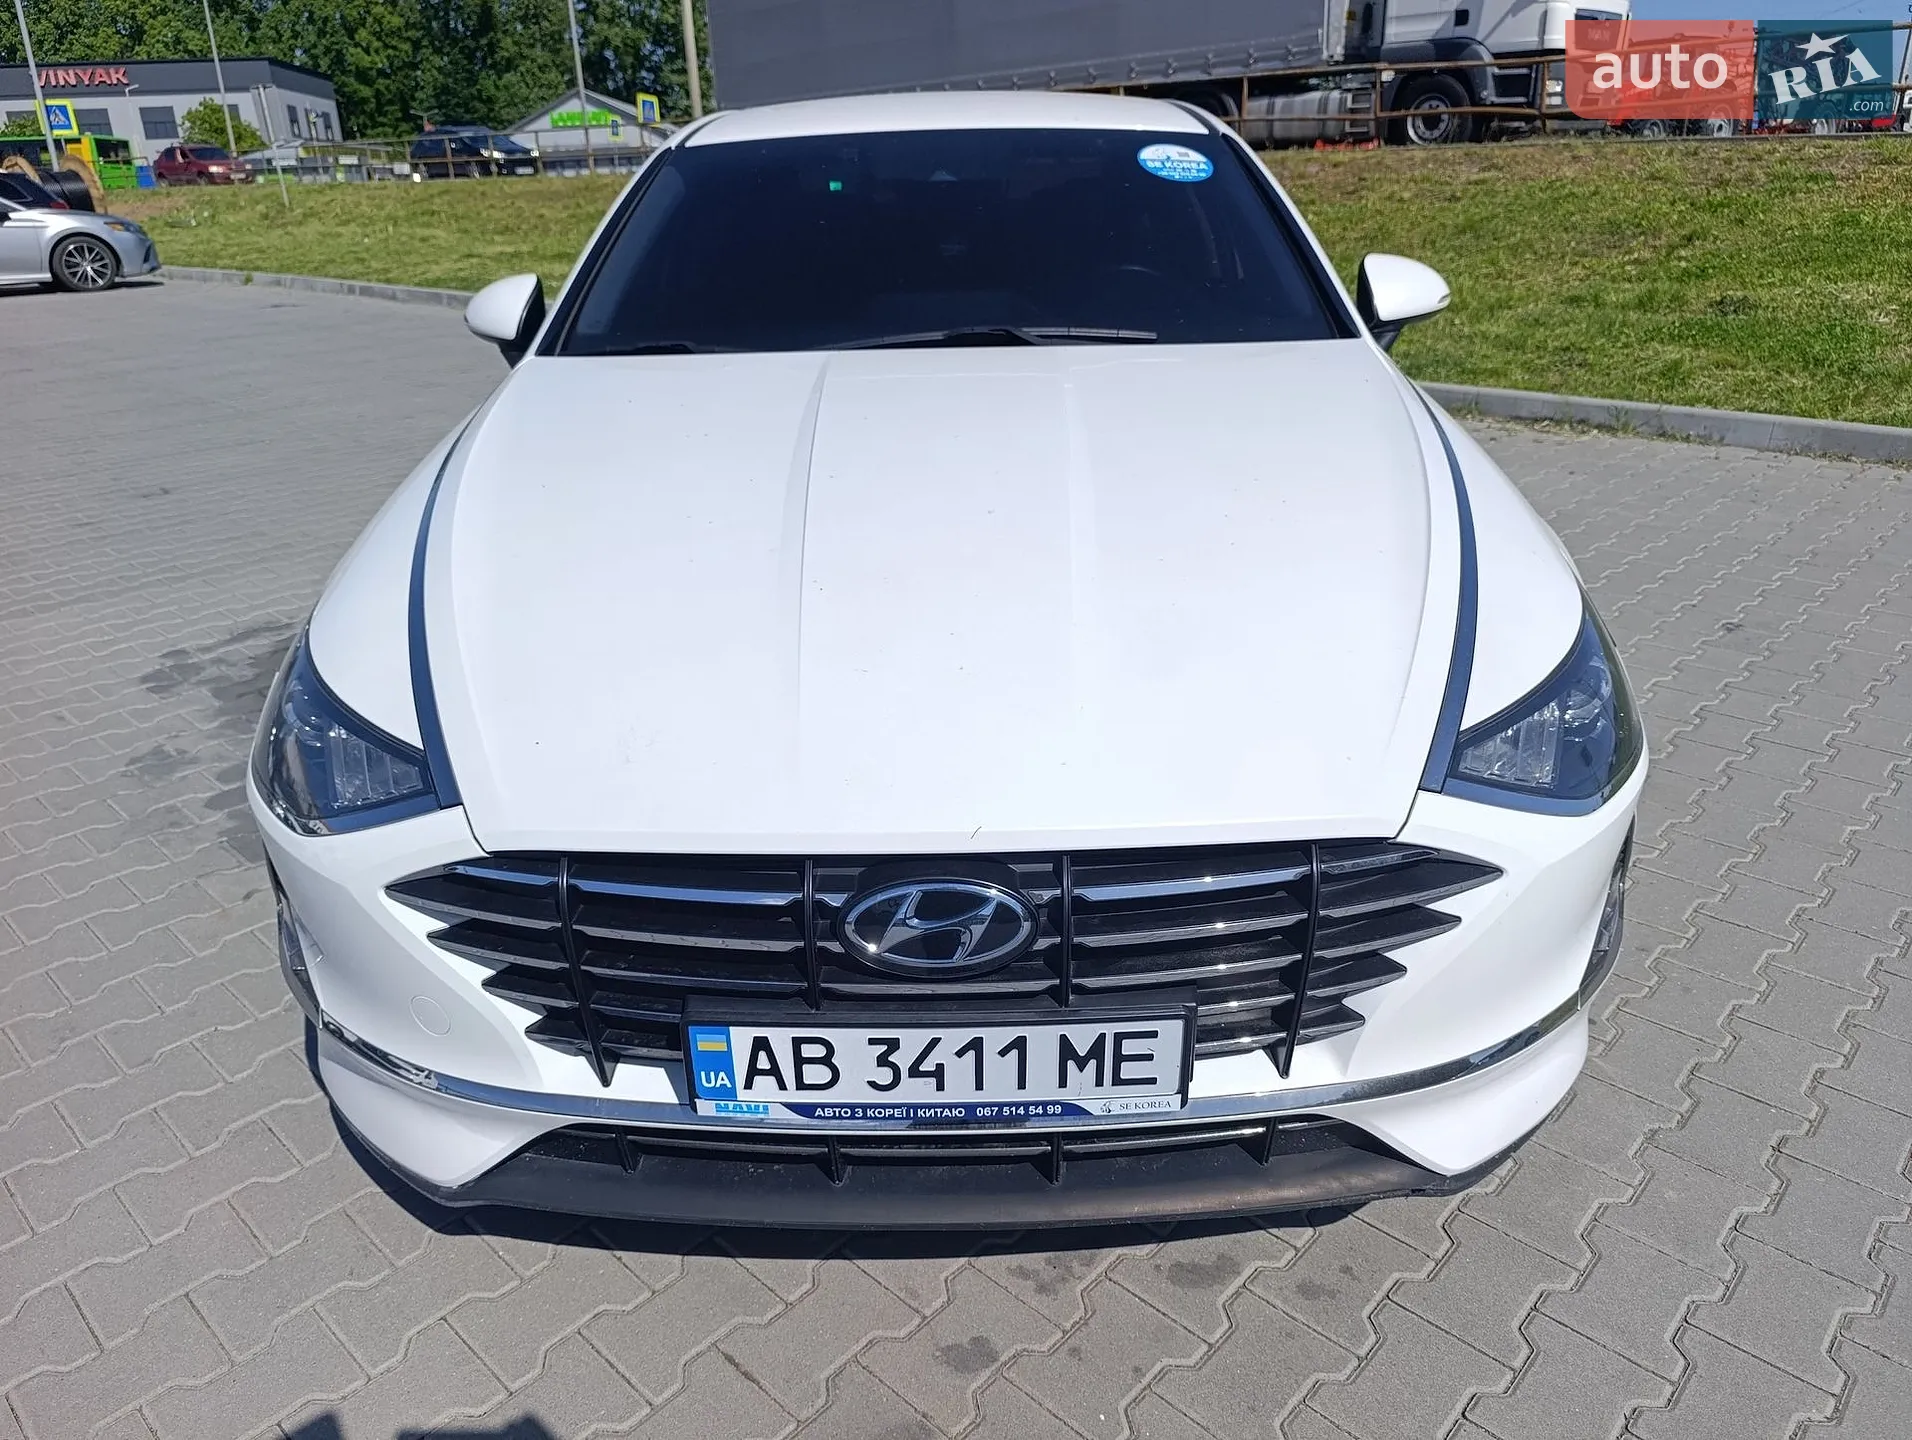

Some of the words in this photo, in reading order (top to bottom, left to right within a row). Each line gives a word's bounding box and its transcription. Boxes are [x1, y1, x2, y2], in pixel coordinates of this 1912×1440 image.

[743, 1036, 841, 1091] AB
[866, 1034, 1028, 1092] 3411
[1057, 1030, 1159, 1089] ME
[700, 1071, 732, 1088] UA
[814, 1107, 851, 1117] АВТО
[866, 1106, 907, 1118] КОРЕЇ
[917, 1108, 965, 1118] КИТАЮ
[976, 1107, 998, 1117] 067
[1002, 1106, 1025, 1116] 514
[1028, 1106, 1044, 1116] 54
[1046, 1105, 1062, 1115] 99
[1119, 1102, 1132, 1110] SE
[1134, 1101, 1172, 1110] KOREA
